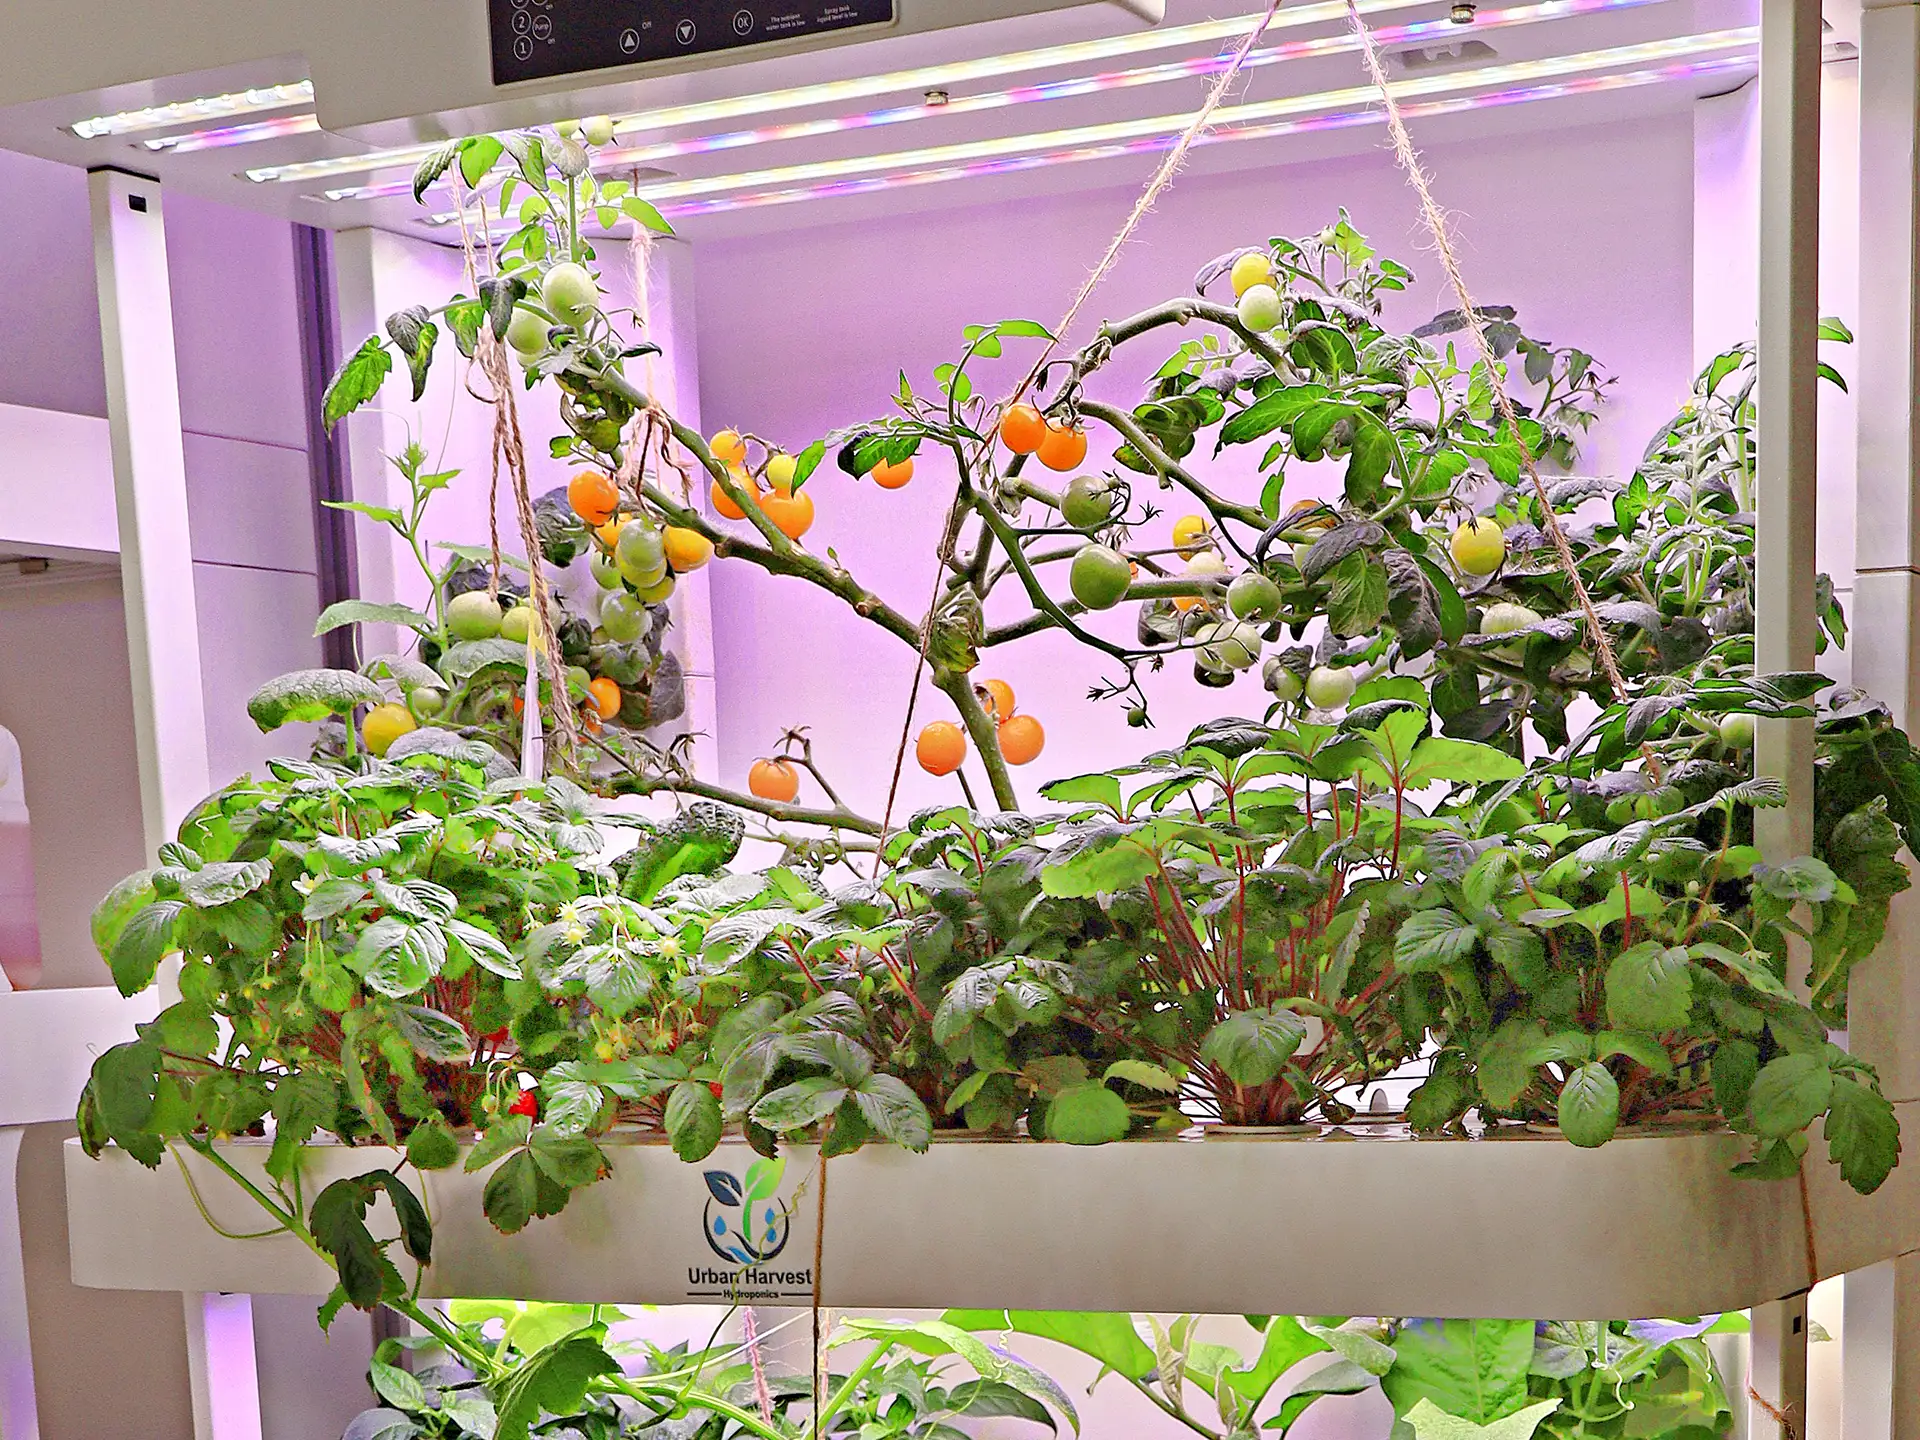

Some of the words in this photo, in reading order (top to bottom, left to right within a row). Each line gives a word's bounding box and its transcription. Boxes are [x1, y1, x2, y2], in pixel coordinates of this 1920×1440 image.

[518, 16, 525, 28] 2
[737, 17, 749, 28] OK
[520, 42, 527, 54] 1
[688, 1267, 740, 1284] Urban
[745, 1267, 812, 1284] Harvest
[723, 1290, 779, 1300] Hydroponics
